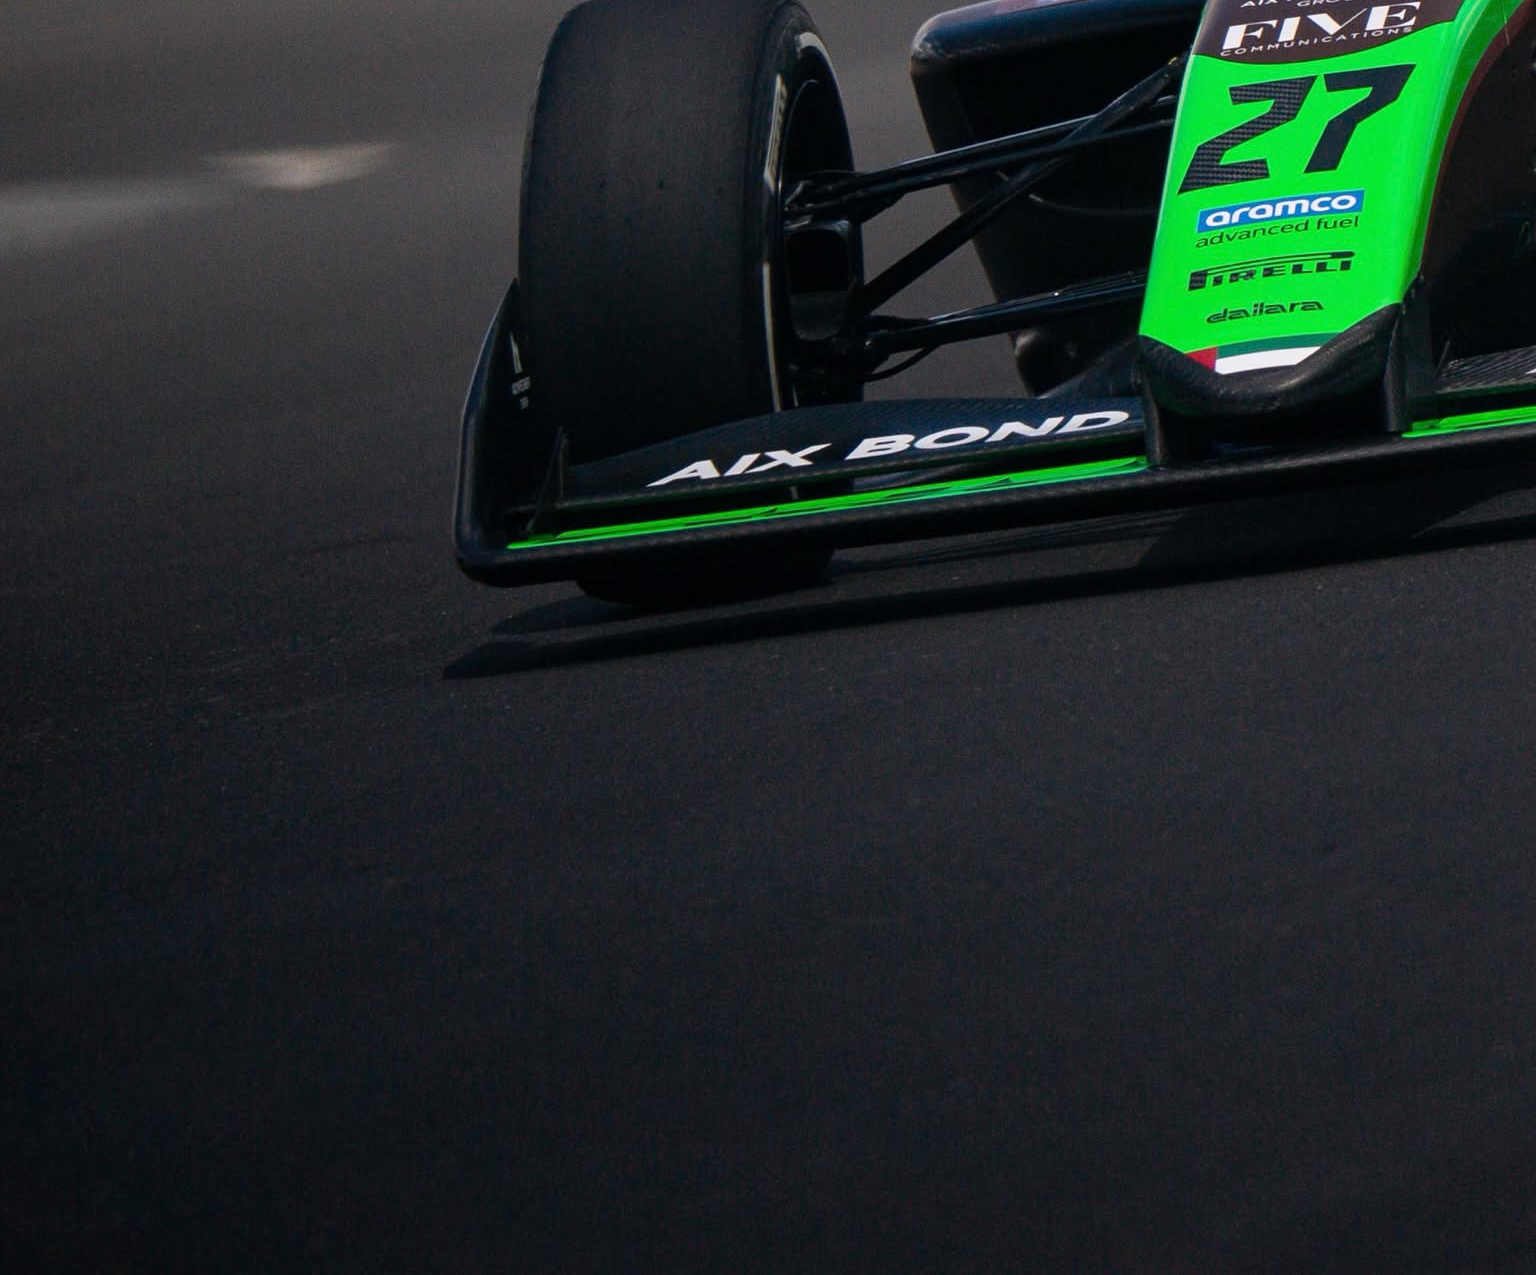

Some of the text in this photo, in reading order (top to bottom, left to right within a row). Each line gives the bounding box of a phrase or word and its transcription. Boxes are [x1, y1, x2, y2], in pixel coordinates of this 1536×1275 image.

[1220, 26, 1413, 57] COMMUNICATIONS
[1222, 1, 1421, 50] FIVE
[1177, 63, 1416, 195] 27
[1205, 194, 1357, 227] aramco
[1195, 216, 1359, 248] advanced fuel
[1188, 251, 1355, 291] PIRELLI
[646, 411, 1130, 487] AIX BOND
